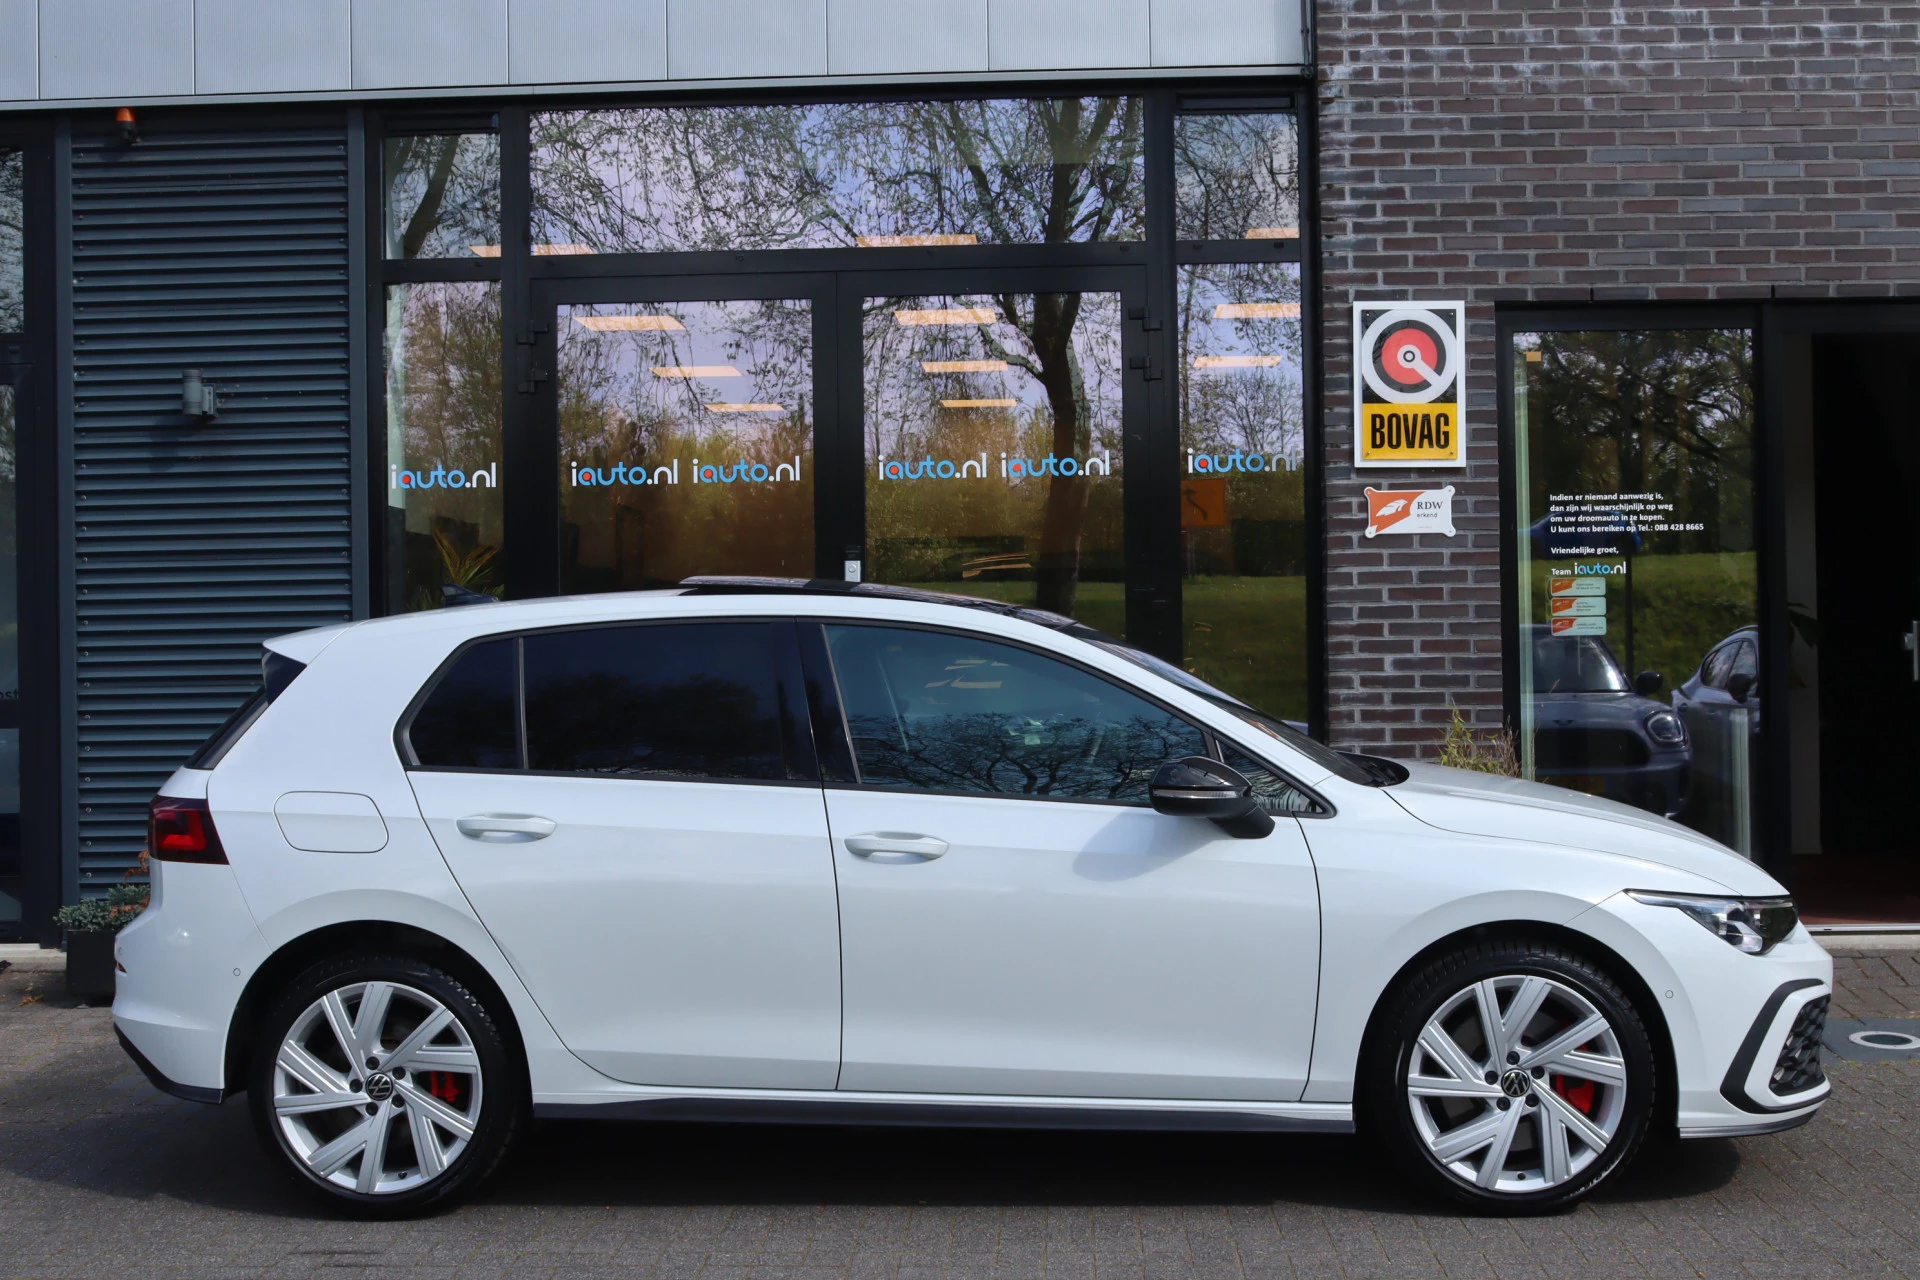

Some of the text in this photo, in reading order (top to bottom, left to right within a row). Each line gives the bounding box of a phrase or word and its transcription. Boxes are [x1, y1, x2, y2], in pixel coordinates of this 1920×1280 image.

[1371, 413, 1449, 450] BOVAG
[692, 455, 800, 484] iauto.nl
[878, 452, 987, 480] iauto.nl
[1001, 449, 1110, 478] iauto.nl
[1187, 447, 1297, 473] iauto.nl
[391, 462, 497, 489] iauto.nl
[571, 458, 679, 487] iauto.nl
[1417, 501, 1443, 510] RDW
[1619, 492, 1654, 501] aanwezig
[1655, 492, 1664, 500] is,
[1550, 504, 1565, 512] dan
[1566, 504, 1579, 513] zijn
[1581, 504, 1592, 513] wij
[1594, 503, 1644, 512] waarschijnlijk
[1658, 503, 1673, 511] weg
[1640, 513, 1665, 522] kopen.
[1551, 525, 1557, 533] U
[1558, 525, 1576, 533] kunt
[1592, 524, 1625, 532] bereiken
[1626, 525, 1636, 533] op
[1654, 523, 1669, 531] 088
[1670, 523, 1684, 531] 428
[1685, 522, 1704, 531] 8665
[1551, 546, 1619, 555] Vriendelijke groet,
[1574, 561, 1626, 575] iauto.nl
